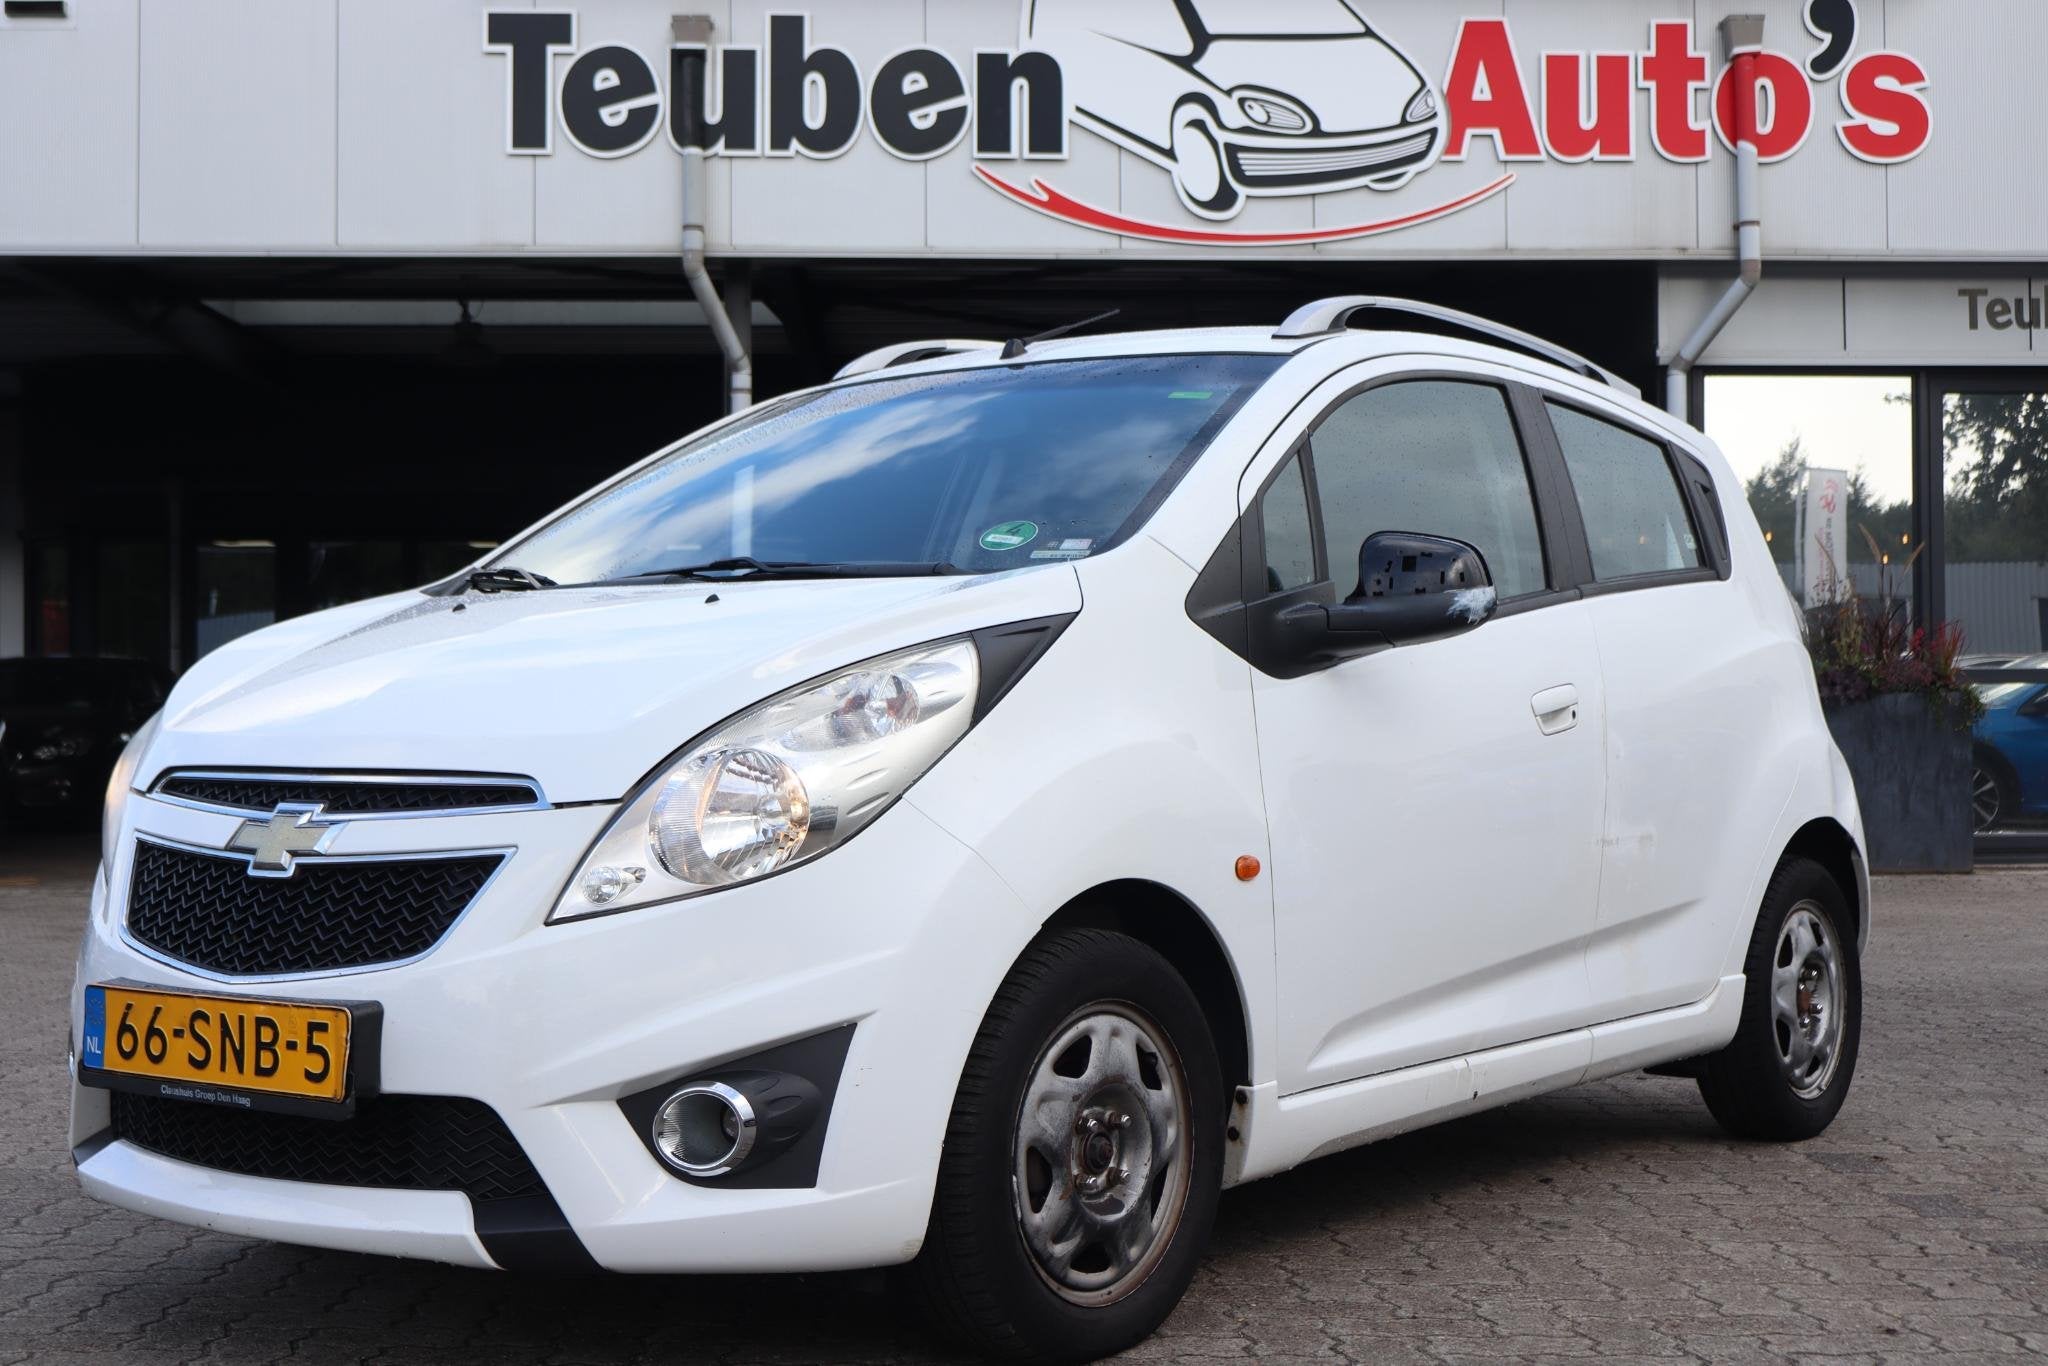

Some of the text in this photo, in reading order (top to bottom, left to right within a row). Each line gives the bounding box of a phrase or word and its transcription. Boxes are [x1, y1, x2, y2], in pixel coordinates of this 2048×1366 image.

[486, 0, 1931, 160] Teuben Auto's
[1958, 285, 2048, 331] Teu
[86, 1035, 101, 1054] NL
[116, 1002, 331, 1084] 66-SNB-5
[195, 1089, 216, 1102] Groep
[217, 1091, 231, 1103] Den
[232, 1093, 251, 1107] Haag
